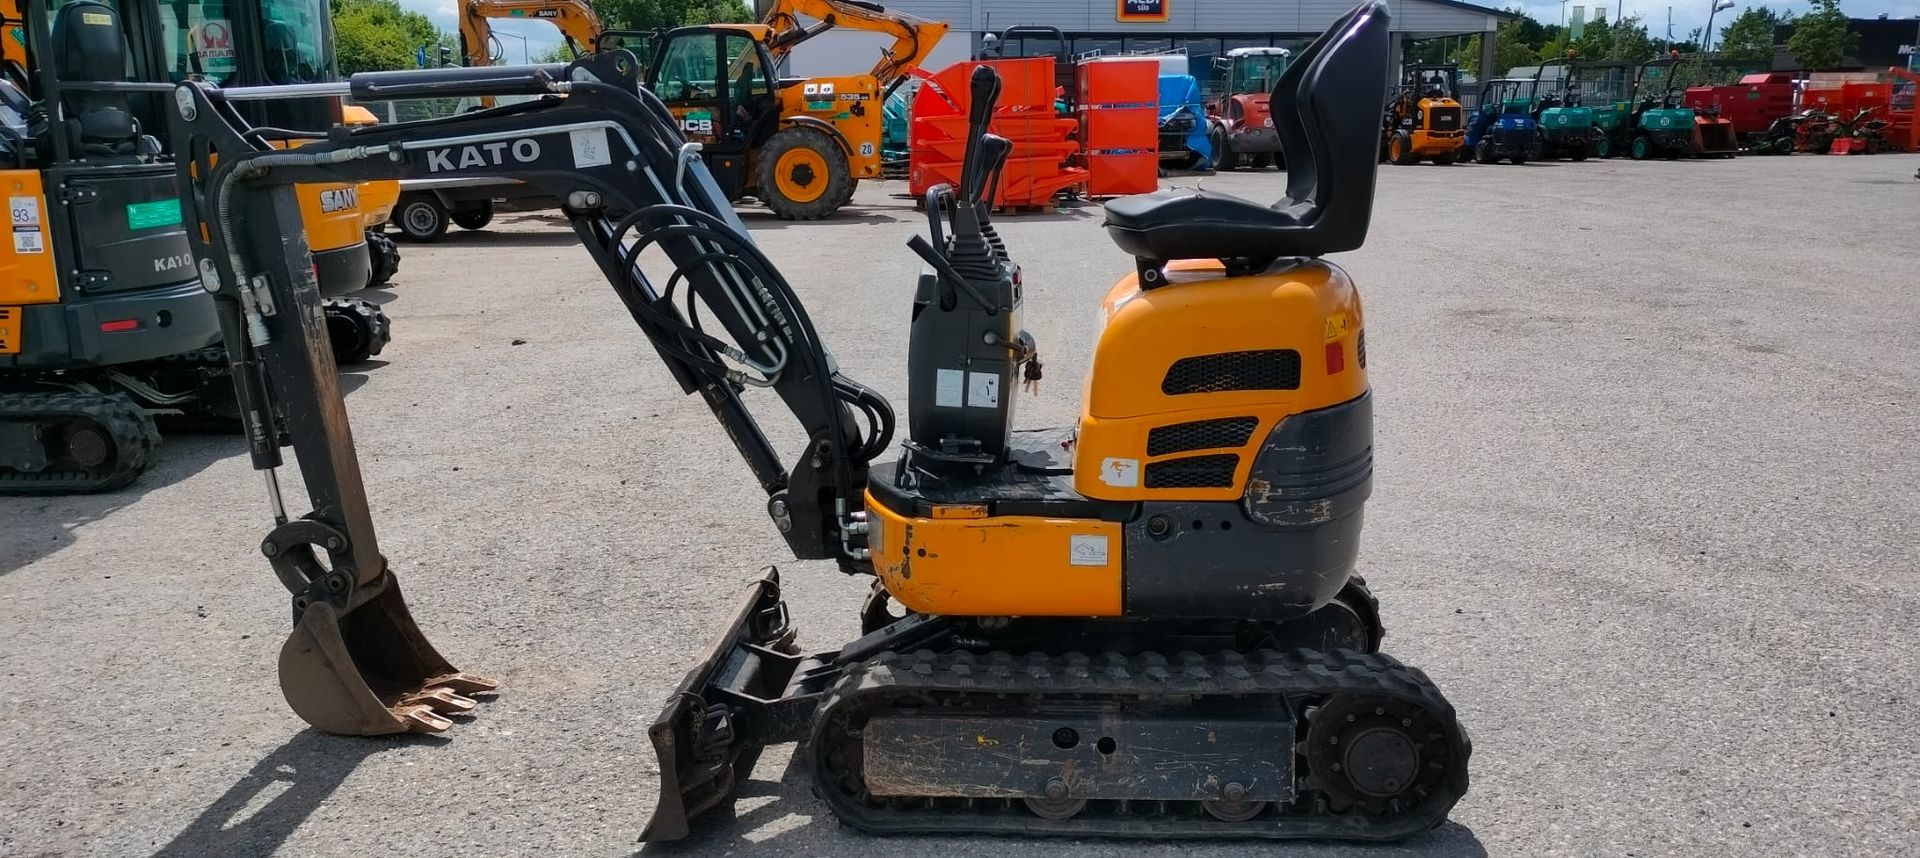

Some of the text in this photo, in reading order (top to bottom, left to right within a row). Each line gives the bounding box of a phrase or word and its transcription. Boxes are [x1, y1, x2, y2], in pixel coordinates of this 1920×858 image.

[426, 138, 541, 173] KATO
[862, 144, 872, 155] 20
[13, 208, 29, 222] 93
